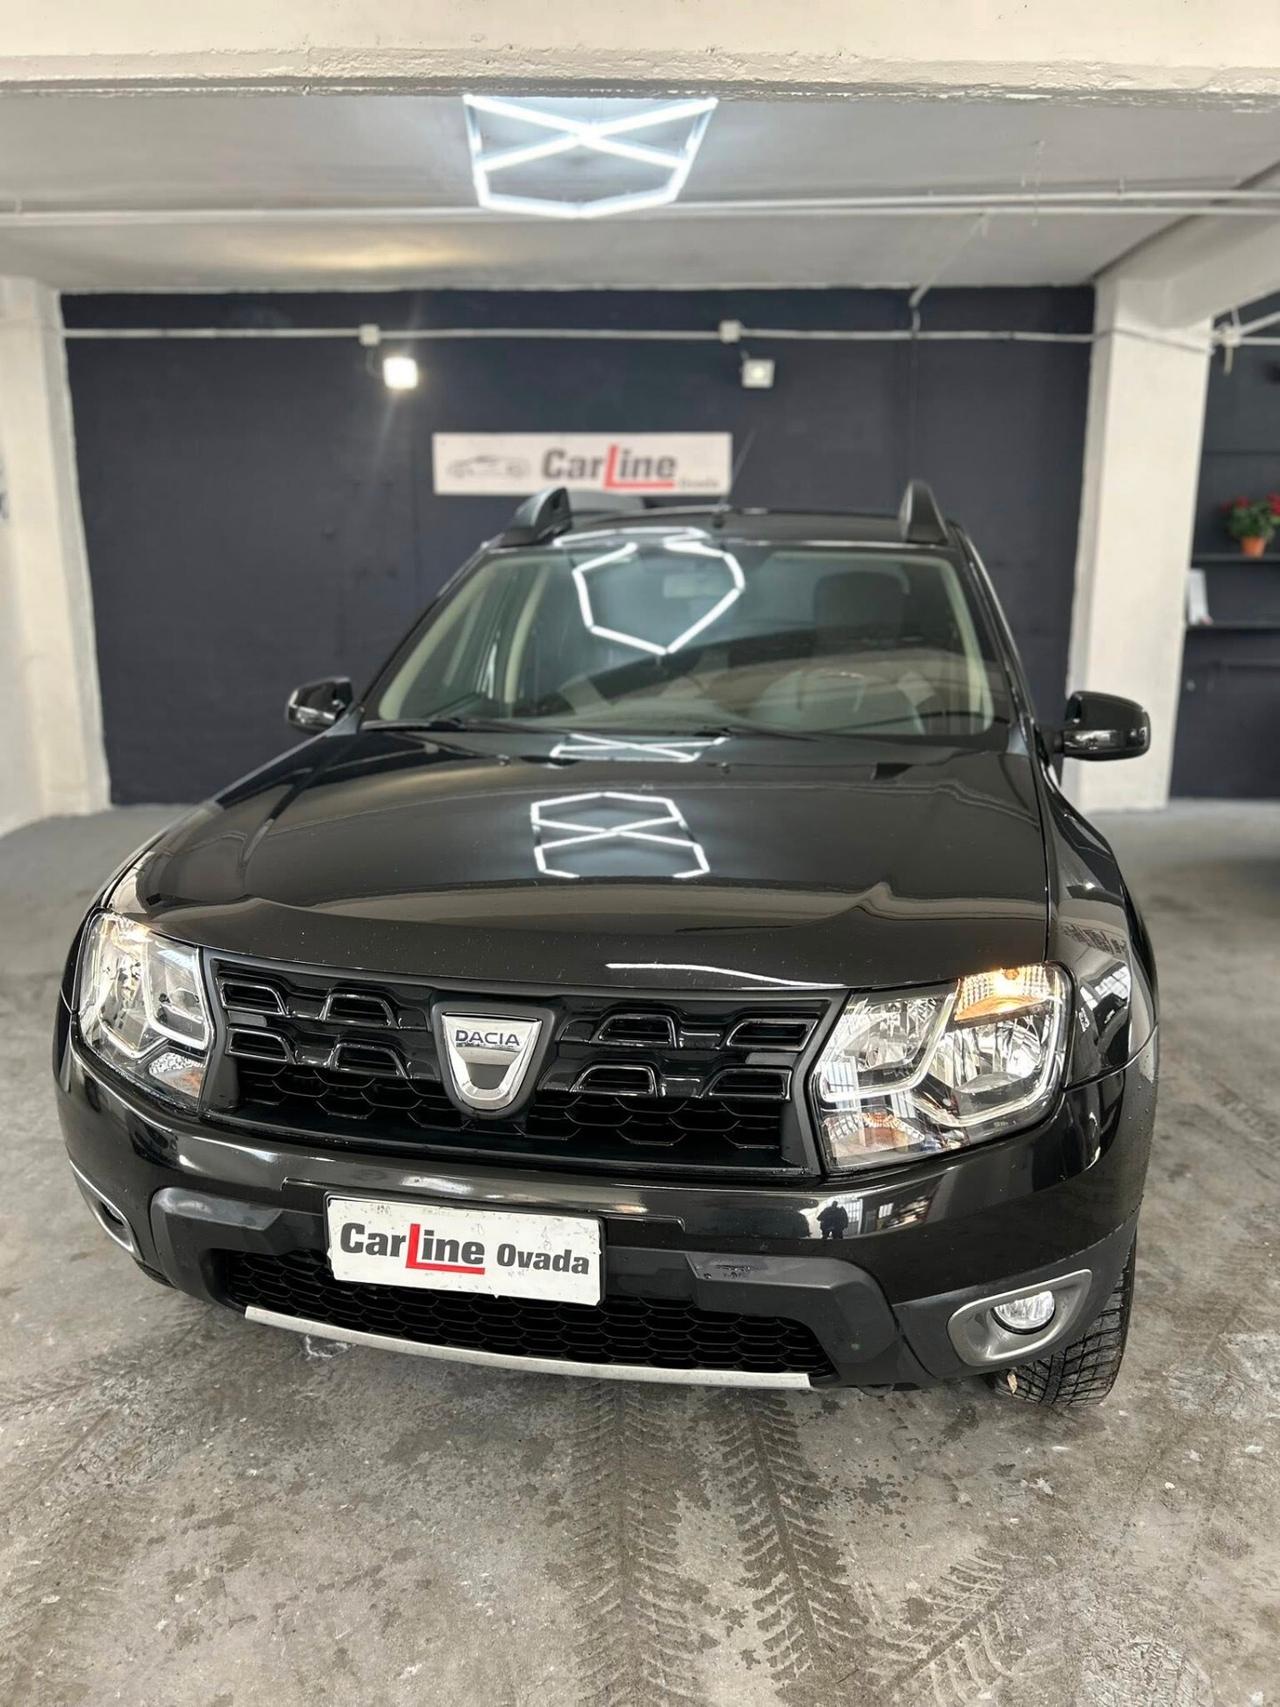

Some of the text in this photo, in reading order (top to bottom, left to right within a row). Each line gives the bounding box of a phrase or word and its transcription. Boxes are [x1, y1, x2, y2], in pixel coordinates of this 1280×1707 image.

[541, 444, 676, 489] CarLine
[455, 1029, 520, 1046] DACIA
[340, 1222, 590, 1275] CarLine Ovada
